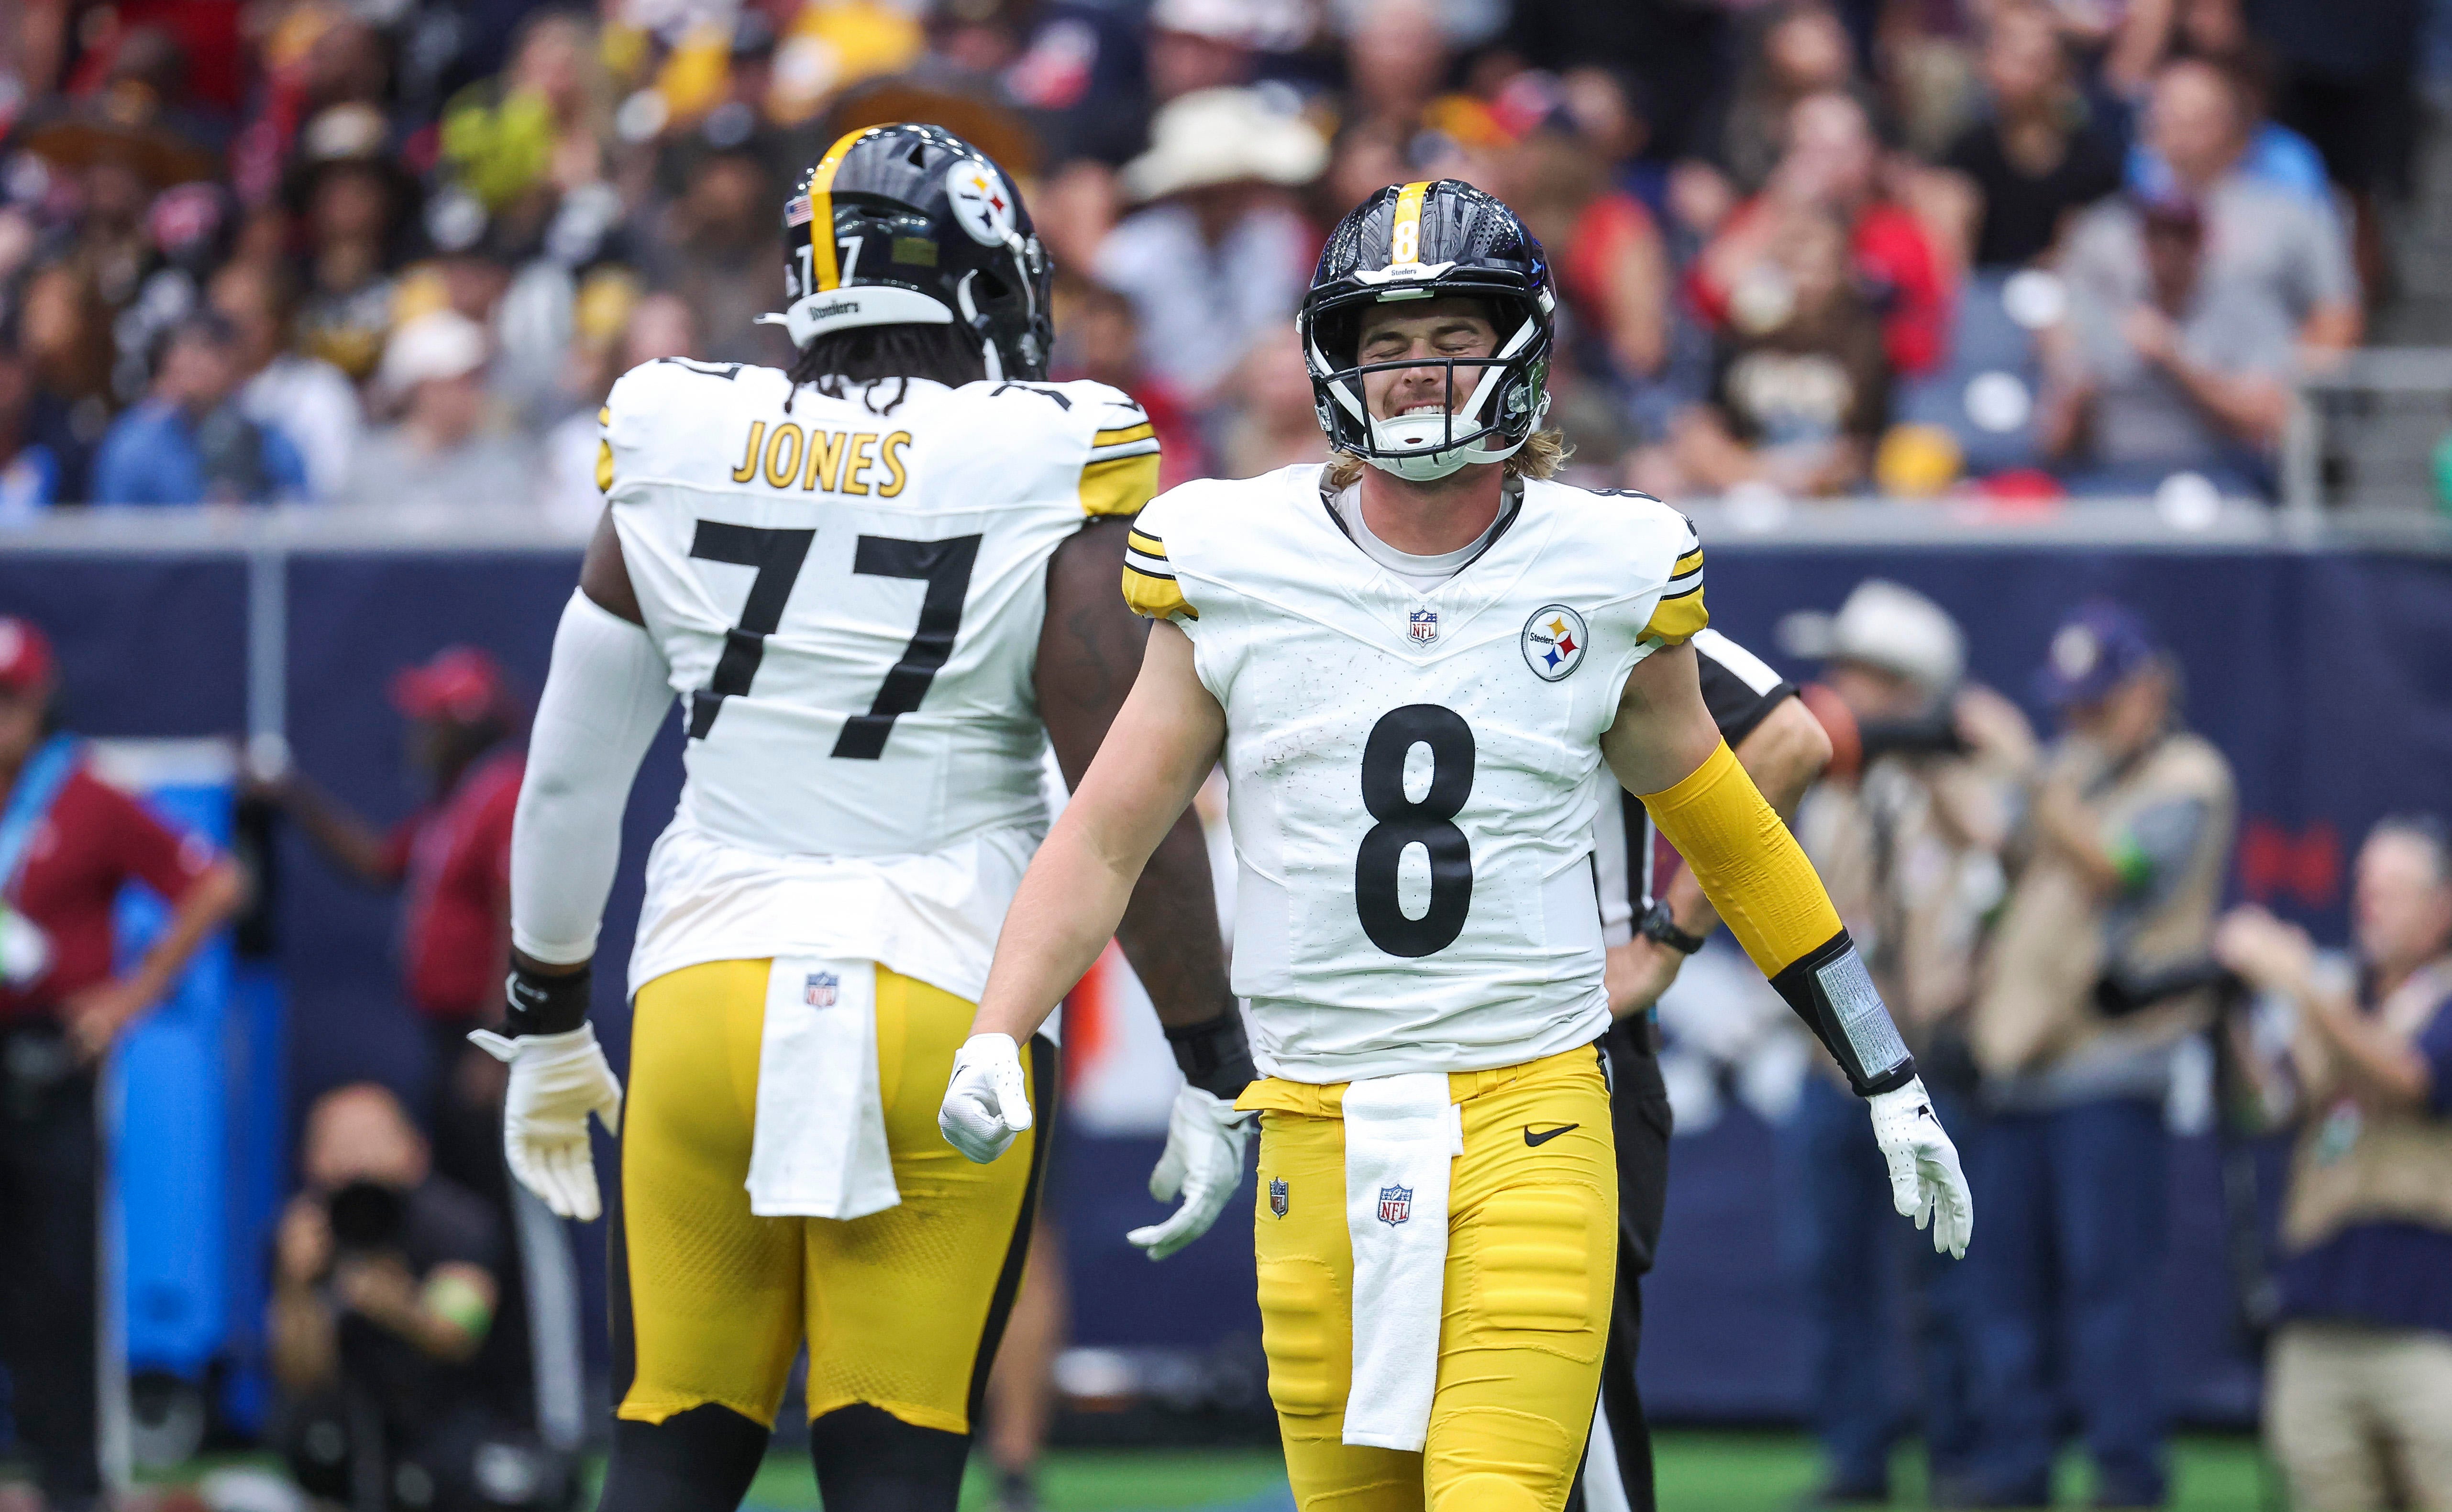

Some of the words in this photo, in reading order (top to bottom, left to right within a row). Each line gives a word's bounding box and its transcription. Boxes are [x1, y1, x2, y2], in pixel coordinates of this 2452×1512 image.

[1393, 220, 1419, 263] 8
[1391, 268, 1417, 276] Steelers
[732, 420, 913, 498] JONES
[689, 519, 983, 760] 77
[1413, 623, 1435, 639] NFL
[1530, 632, 1555, 645] Steelers
[1355, 703, 1476, 958] 8
[1380, 1202, 1407, 1221] NFL
